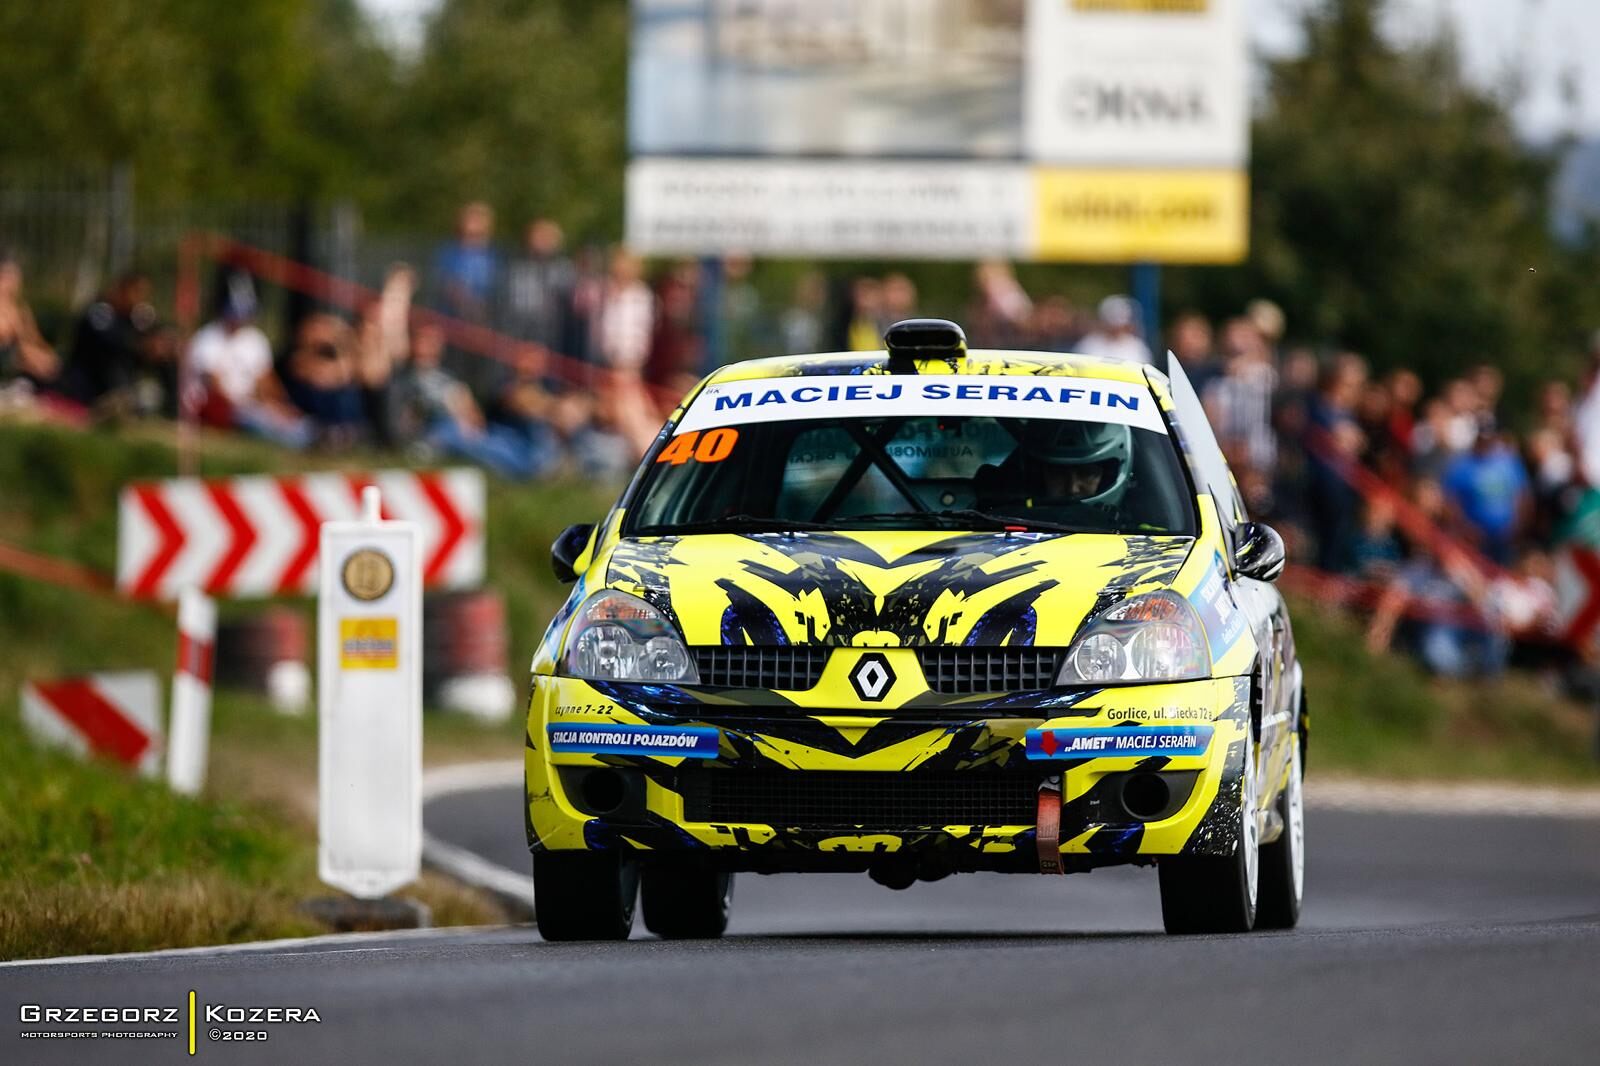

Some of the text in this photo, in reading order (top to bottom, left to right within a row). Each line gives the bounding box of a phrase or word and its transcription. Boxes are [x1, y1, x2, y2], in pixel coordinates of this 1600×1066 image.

[714, 384, 1139, 412] MACIEJ SERAFIN
[657, 428, 739, 466] 40
[1107, 708, 1151, 720] Gorlice,
[1153, 707, 1168, 719] ul.
[552, 731, 699, 748] STACJA KONTROLI POJAZDÓW
[1115, 736, 1157, 749] MACIEJ
[1158, 735, 1197, 748] SERAFIN
